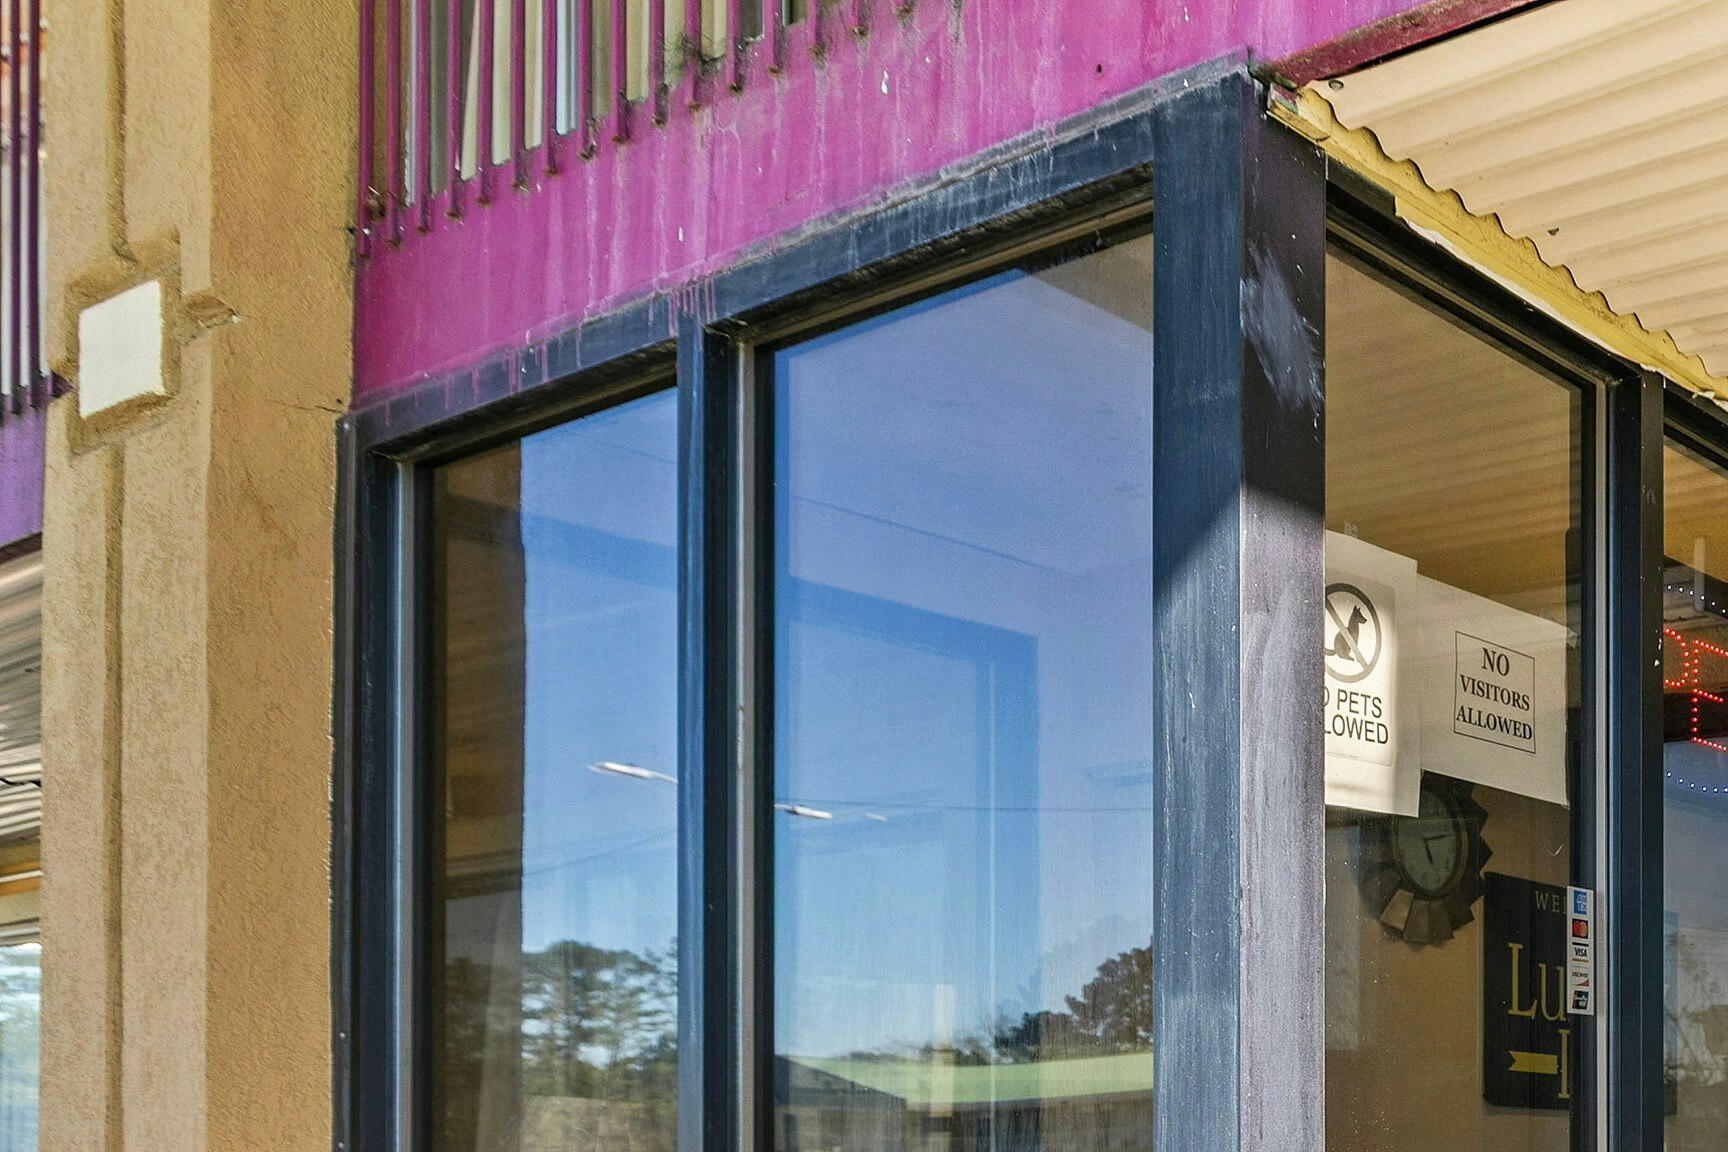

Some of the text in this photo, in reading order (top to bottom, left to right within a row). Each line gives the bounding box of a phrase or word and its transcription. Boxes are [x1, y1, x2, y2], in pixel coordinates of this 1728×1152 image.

[1481, 646, 1510, 676] NO
[1337, 688, 1382, 719] PETS
[1459, 673, 1531, 711] VISITORS
[1324, 713, 1389, 745] OWED
[1456, 704, 1533, 740] ALLOWED
[1574, 947, 1588, 957] VISA
